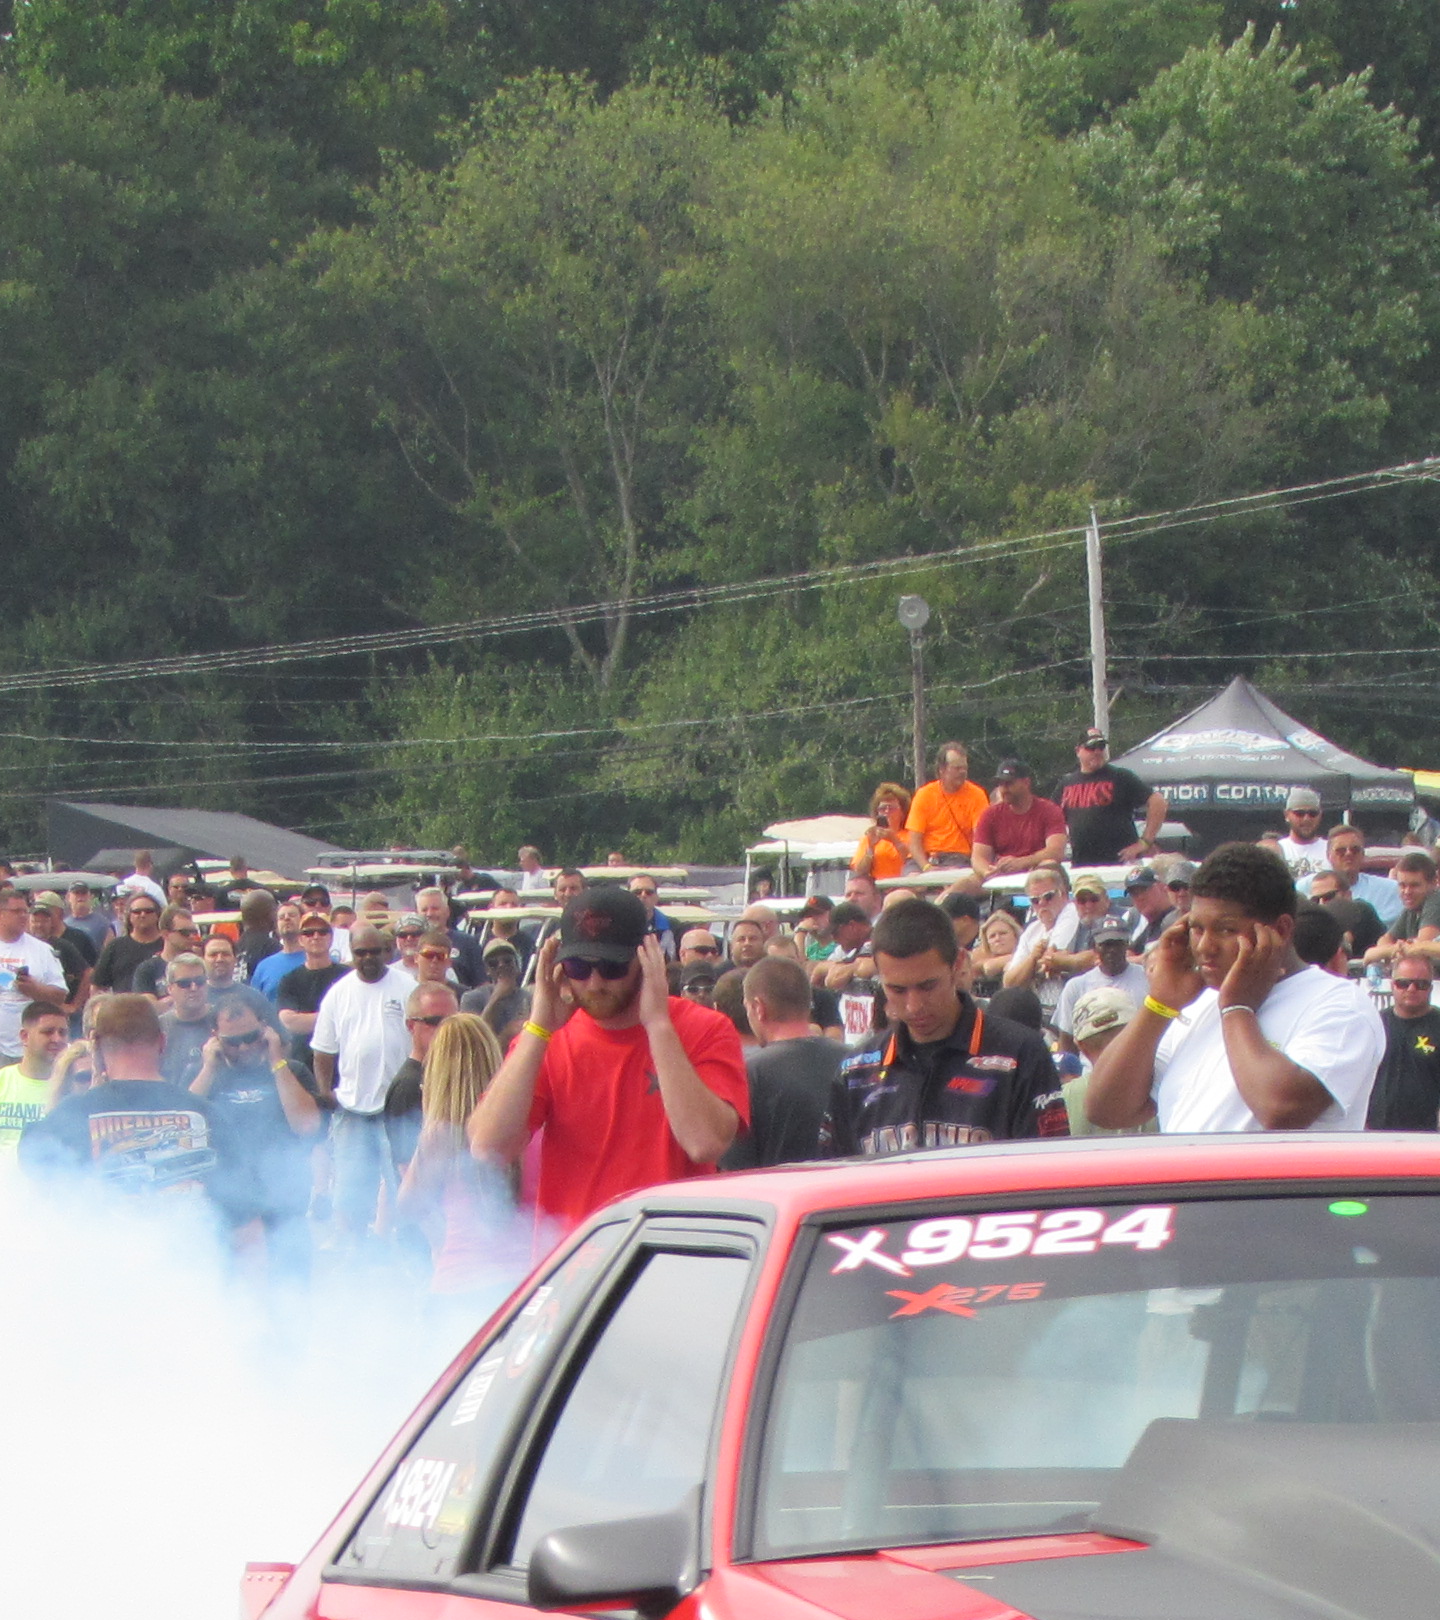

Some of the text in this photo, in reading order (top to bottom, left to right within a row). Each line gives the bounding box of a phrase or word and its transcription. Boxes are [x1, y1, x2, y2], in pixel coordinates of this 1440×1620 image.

[1152, 784, 1208, 800] TION
[824, 1204, 1176, 1279] X9524
[884, 1282, 1048, 1320] X275
